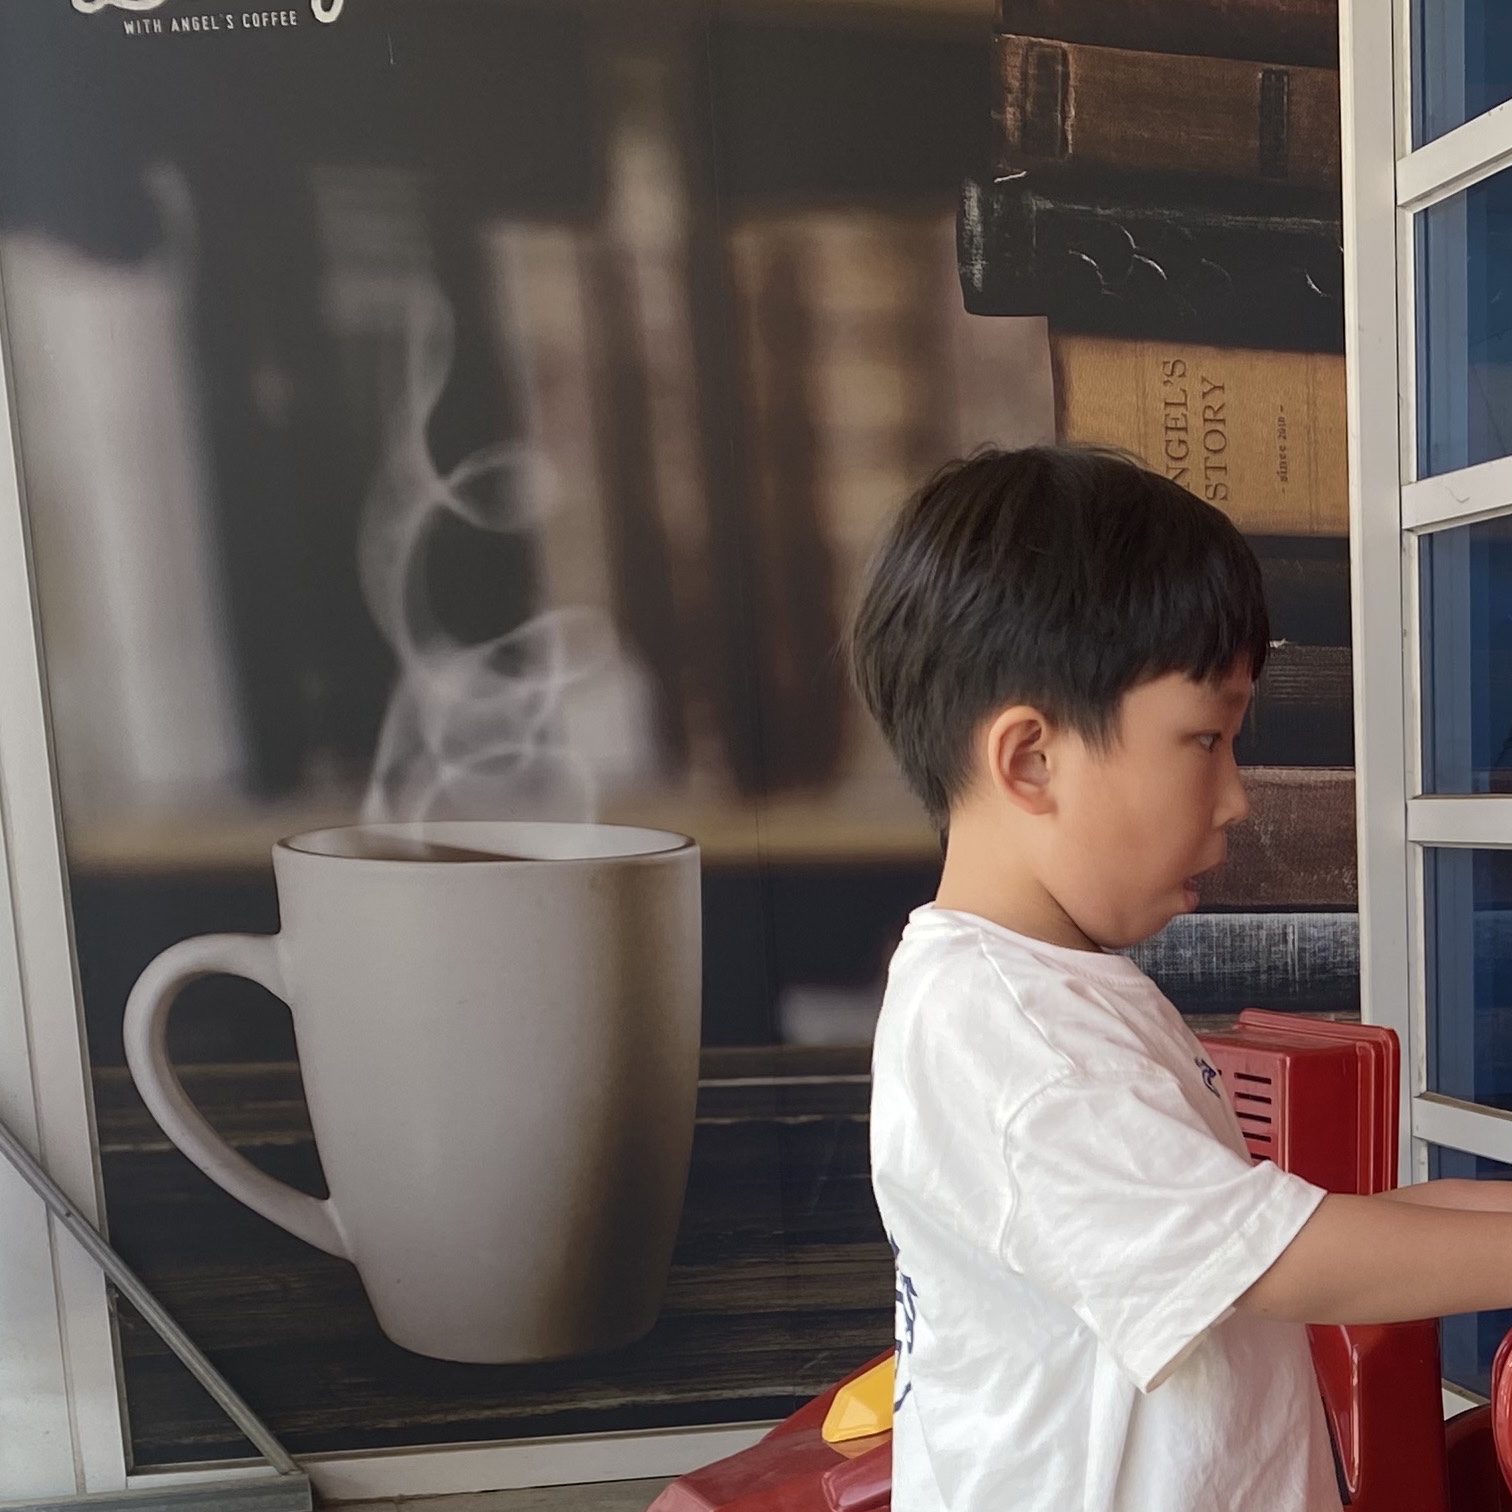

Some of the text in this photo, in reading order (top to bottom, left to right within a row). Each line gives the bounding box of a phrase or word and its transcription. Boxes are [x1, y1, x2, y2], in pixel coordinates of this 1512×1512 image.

[124, 18, 163, 35] WITH
[242, 10, 298, 28] COFFEE
[1163, 359, 1190, 489] NGEL'S
[1202, 376, 1228, 500] STORY
